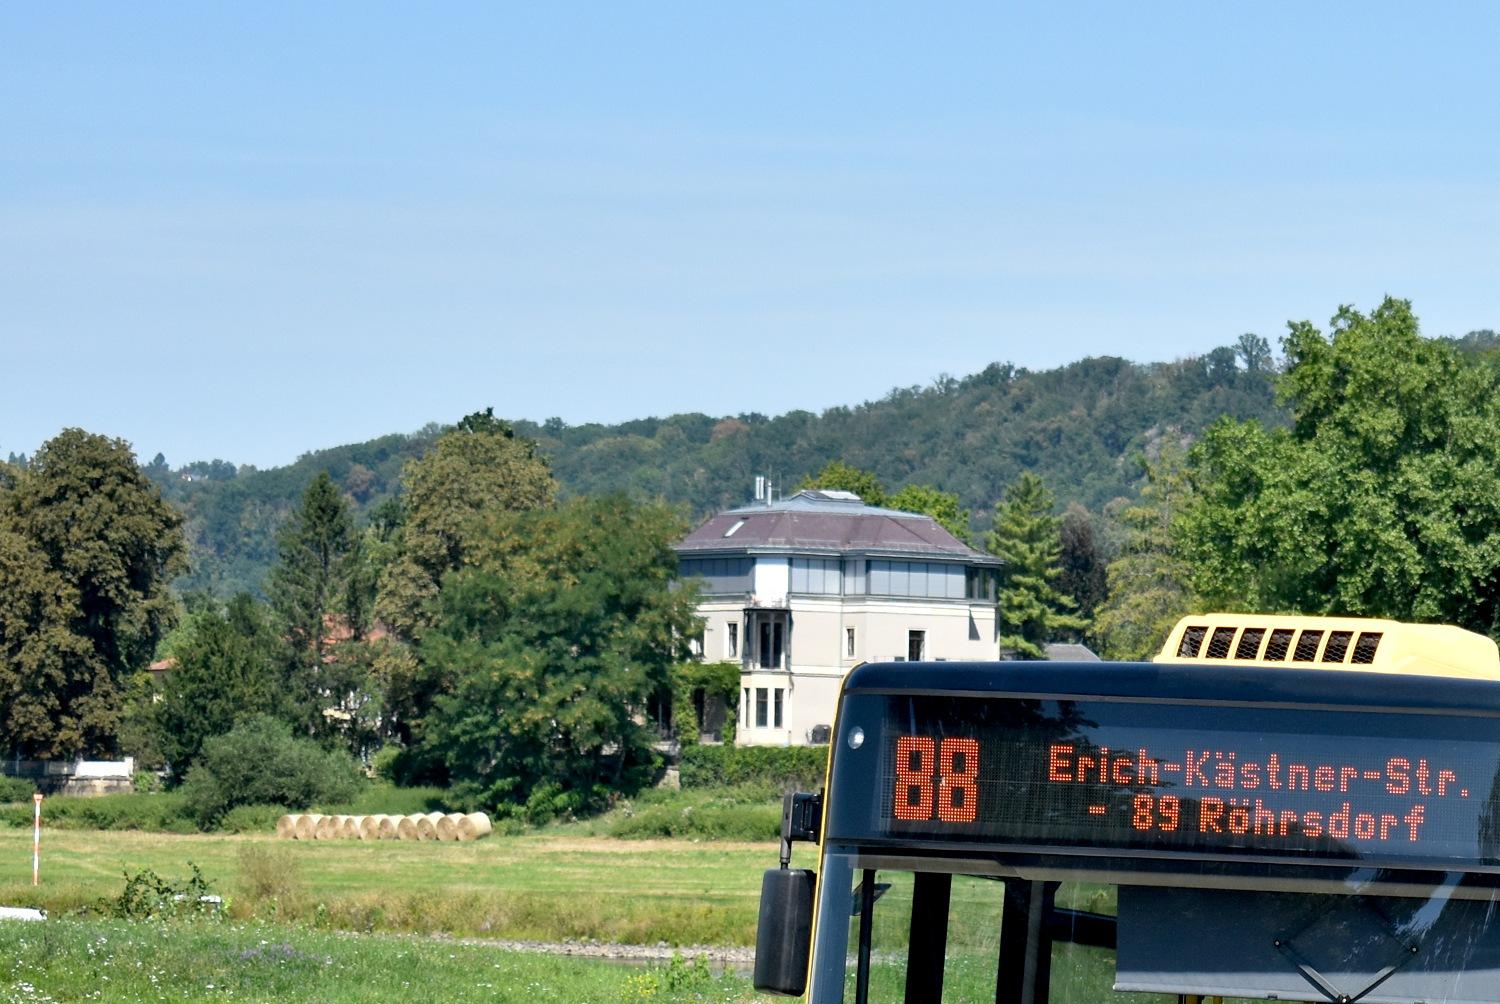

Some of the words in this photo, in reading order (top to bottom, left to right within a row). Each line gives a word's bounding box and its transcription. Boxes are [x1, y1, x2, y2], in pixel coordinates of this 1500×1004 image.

[894, 736, 980, 824] 88
[1049, 744, 1470, 799] Erich-Kästner-Str.
[1132, 794, 1180, 833] 89
[1199, 795, 1426, 843] Röhrsdorf
